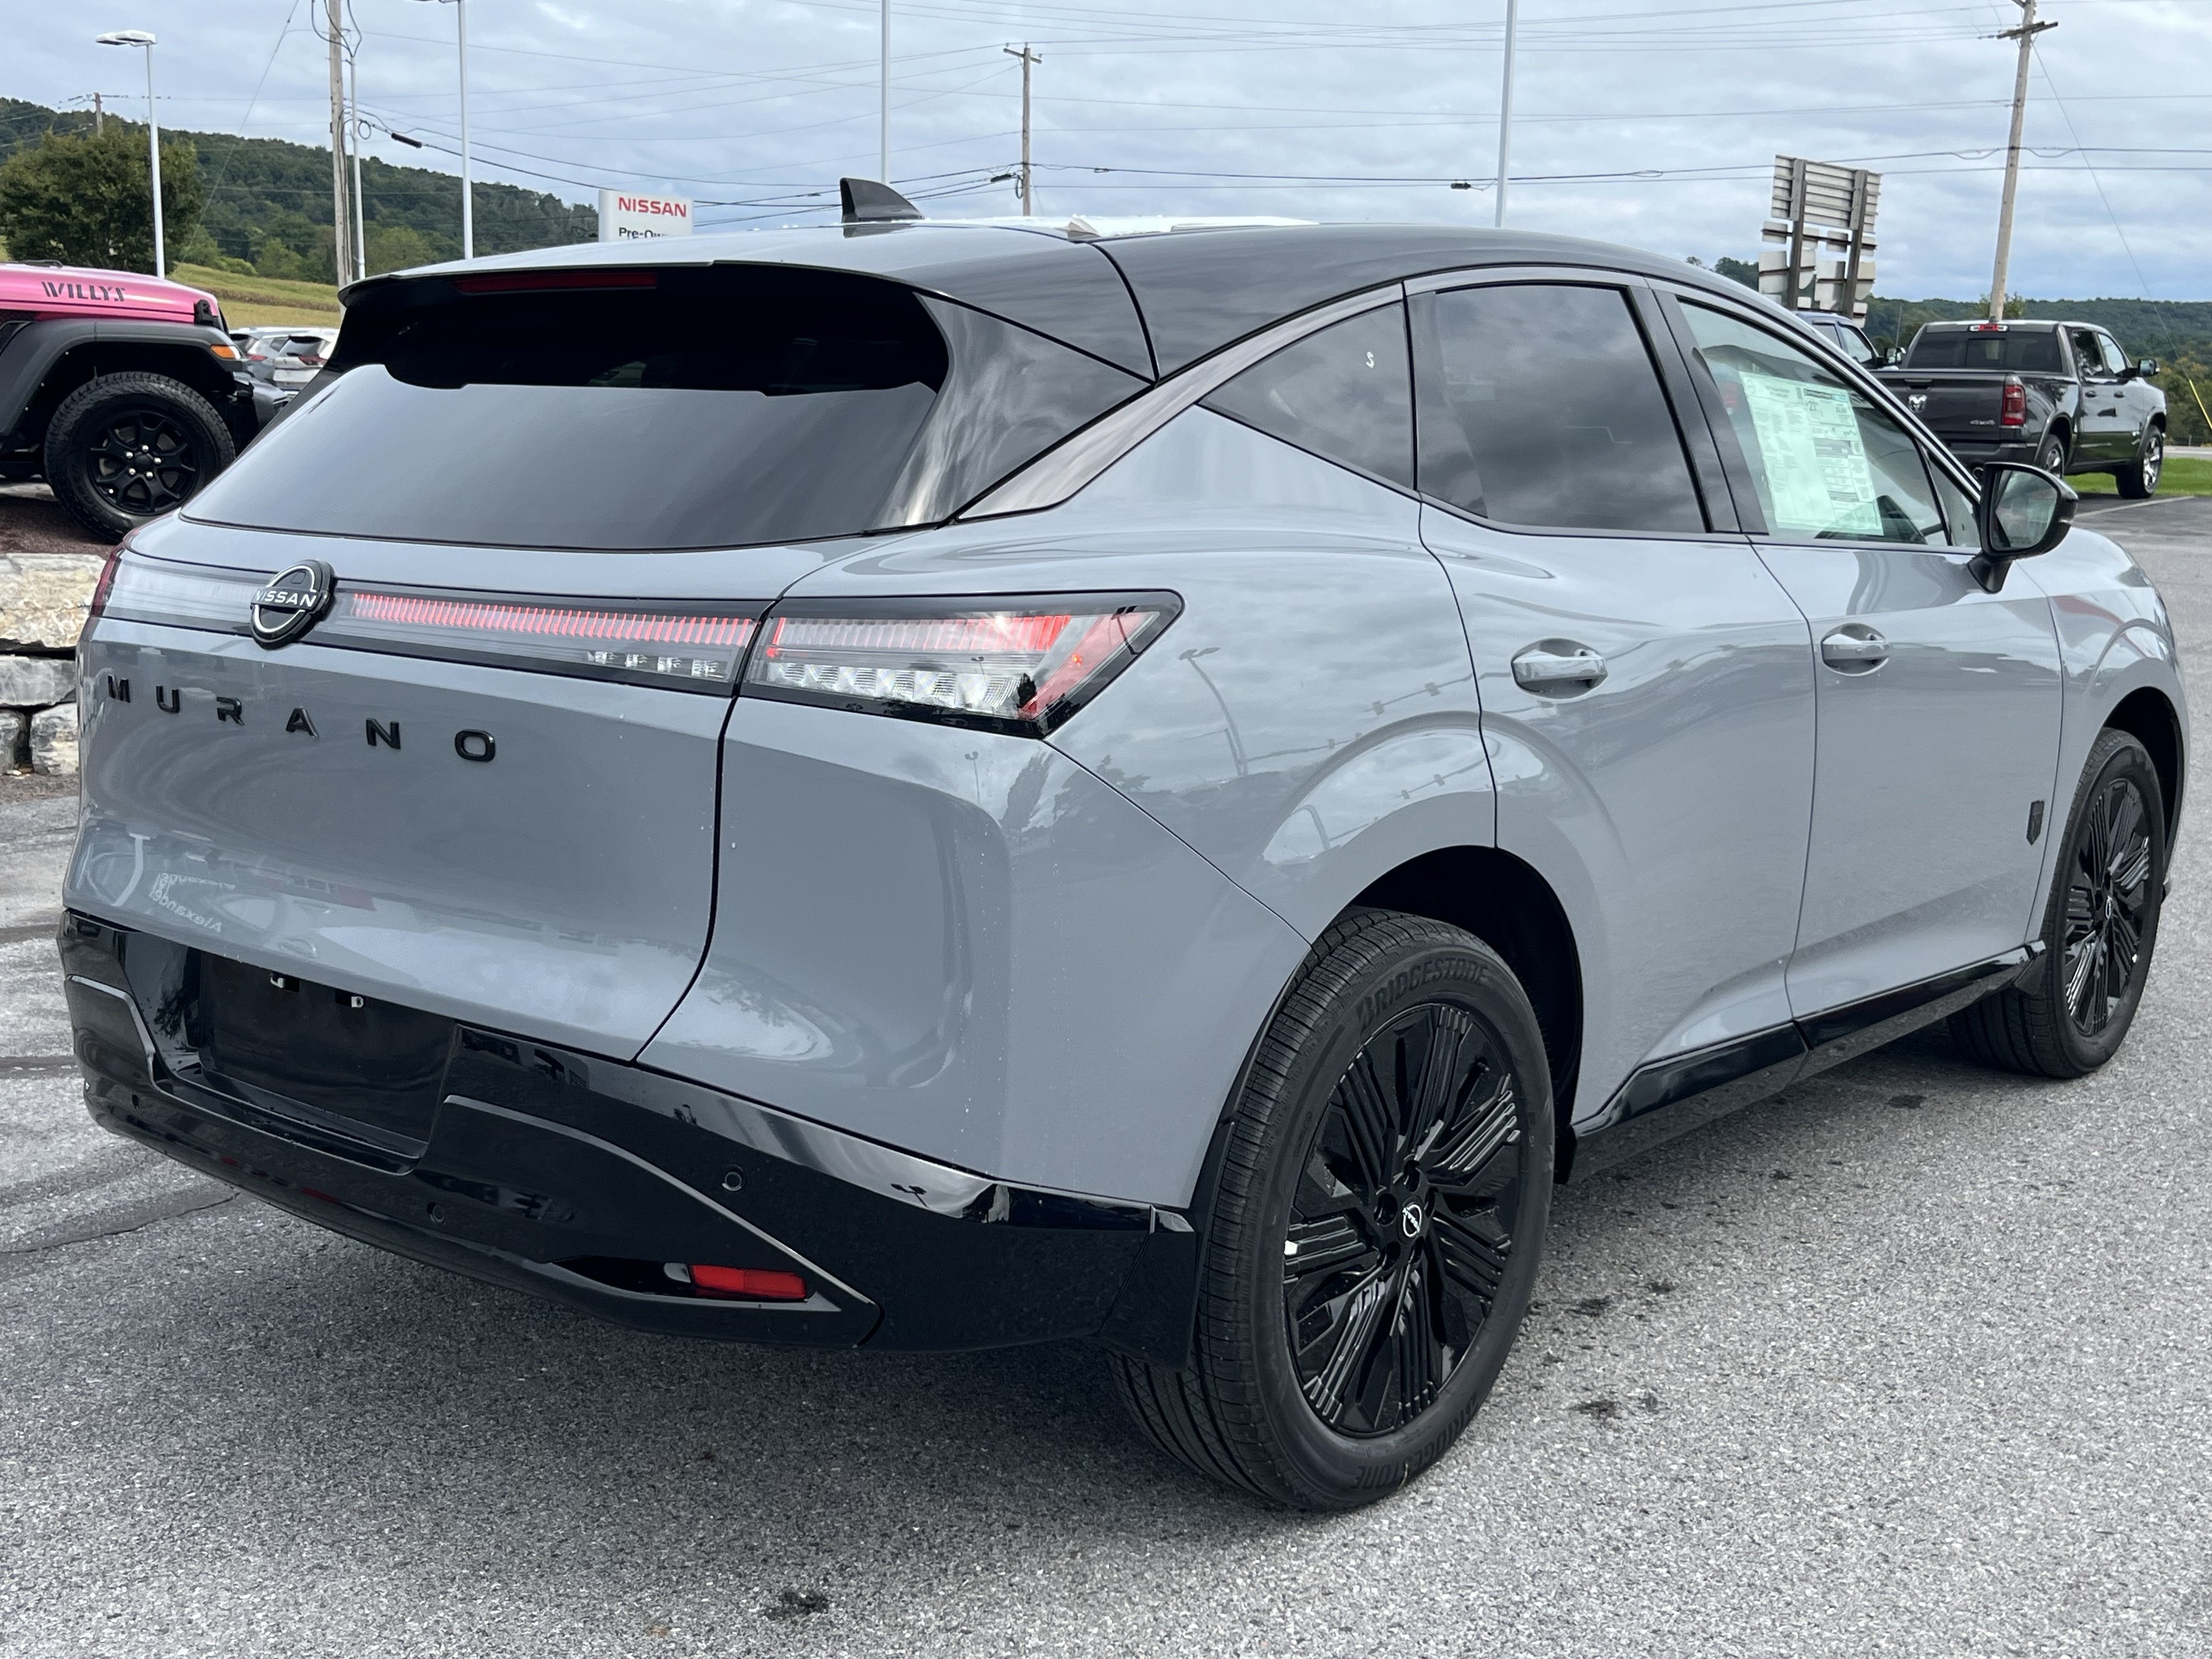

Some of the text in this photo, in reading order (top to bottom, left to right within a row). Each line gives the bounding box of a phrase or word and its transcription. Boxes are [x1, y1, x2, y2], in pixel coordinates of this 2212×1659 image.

[619, 198, 686, 217] NISSAN
[619, 227, 668, 239] Pre-O
[41, 281, 126, 302] WILLYS
[256, 590, 317, 607] NISSAN
[108, 675, 496, 762] MURANO
[1356, 957, 1488, 1036] BRIDGESTONE
